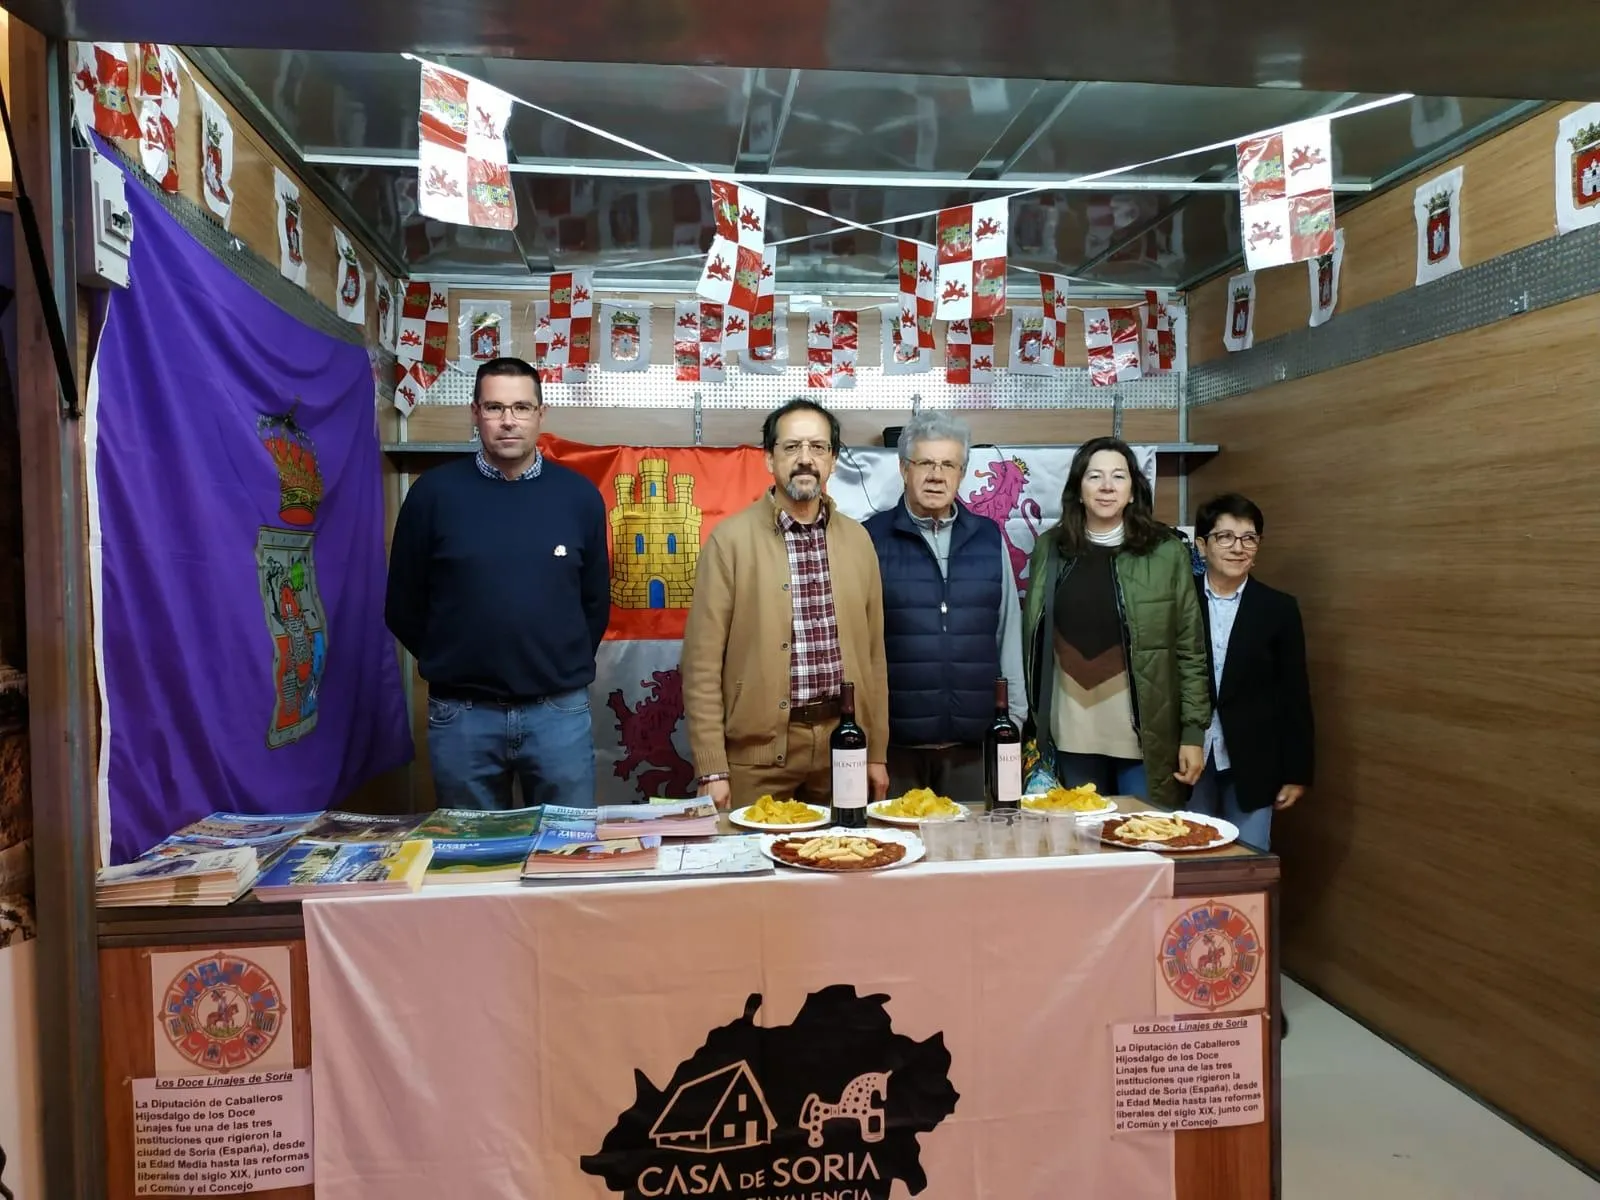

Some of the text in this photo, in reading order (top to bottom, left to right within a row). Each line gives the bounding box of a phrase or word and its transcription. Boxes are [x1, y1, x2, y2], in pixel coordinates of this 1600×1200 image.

[1133, 1019, 1248, 1033] Los Doce Linajes de Soria
[1129, 1043, 1178, 1053] Diputación
[1194, 1039, 1240, 1049] Caballeros
[1116, 1052, 1219, 1064] Hijosdalgo de los Doce
[1116, 1066, 1148, 1075] Linajes
[1151, 1065, 1165, 1073] fue
[156, 1072, 292, 1088] Los Doce Linajes de Soria
[1116, 1072, 1240, 1085] instituciones que rigieron la
[1116, 1088, 1146, 1096] ciudad
[1149, 1087, 1160, 1095] de
[1163, 1086, 1186, 1094] Soria
[1233, 1081, 1258, 1090] desde
[136, 1094, 282, 1110] La Diputación de Caballeros
[1117, 1099, 1124, 1107] la
[1153, 1097, 1179, 1106] Media
[1182, 1096, 1207, 1104] hasta
[1209, 1095, 1222, 1103] las
[1224, 1092, 1261, 1102] reformas
[136, 1108, 255, 1121] Hijosdalgo de los Doce
[1117, 1110, 1155, 1118] liberales
[1158, 1109, 1172, 1117] del
[1174, 1108, 1196, 1118] siglo
[1219, 1105, 1240, 1115] junto
[1243, 1103, 1258, 1111] con
[136, 1124, 172, 1134] Linajes
[176, 1123, 191, 1131] fue
[217, 1122, 229, 1130] de
[233, 1121, 248, 1129] las
[252, 1119, 272, 1128] tres
[1117, 1121, 1124, 1129] el
[1127, 1120, 1160, 1128] Común
[1162, 1121, 1168, 1129] y
[1181, 1118, 1218, 1128] Concejo
[137, 1130, 282, 1145] instituciones que rigieron la
[137, 1148, 170, 1156] ciudad
[174, 1148, 186, 1156] de
[190, 1147, 215, 1156] Soria
[273, 1140, 305, 1150] desde
[138, 1153, 309, 1168] la Edad Media hasta las reformas
[138, 1172, 180, 1180] liberales
[184, 1172, 198, 1180] del
[202, 1171, 226, 1182] siglo
[254, 1166, 281, 1178] junto
[285, 1165, 304, 1174] con
[638, 1152, 880, 1197] CASA DE SORIA
[138, 1182, 253, 1194] el Común y el Concejo
